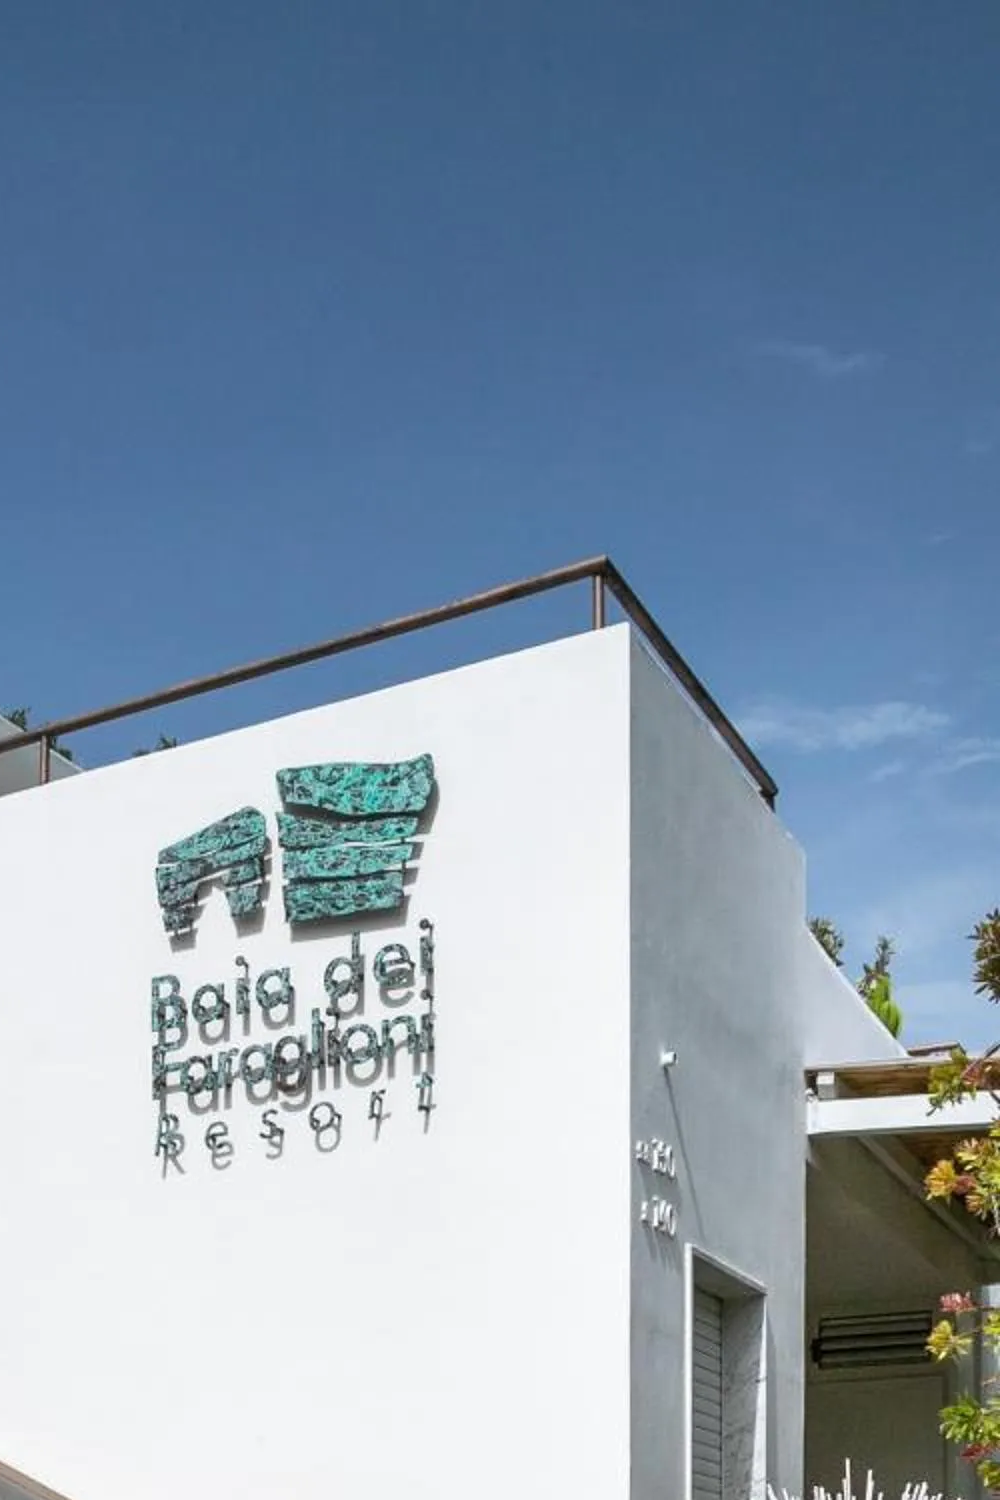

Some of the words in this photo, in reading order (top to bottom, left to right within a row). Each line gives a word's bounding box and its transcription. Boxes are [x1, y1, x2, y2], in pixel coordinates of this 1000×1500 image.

[151, 955, 295, 1034] Baia
[323, 918, 434, 1003] dei
[151, 989, 435, 1101] Faraglioni
[155, 1072, 433, 1158] Resort
